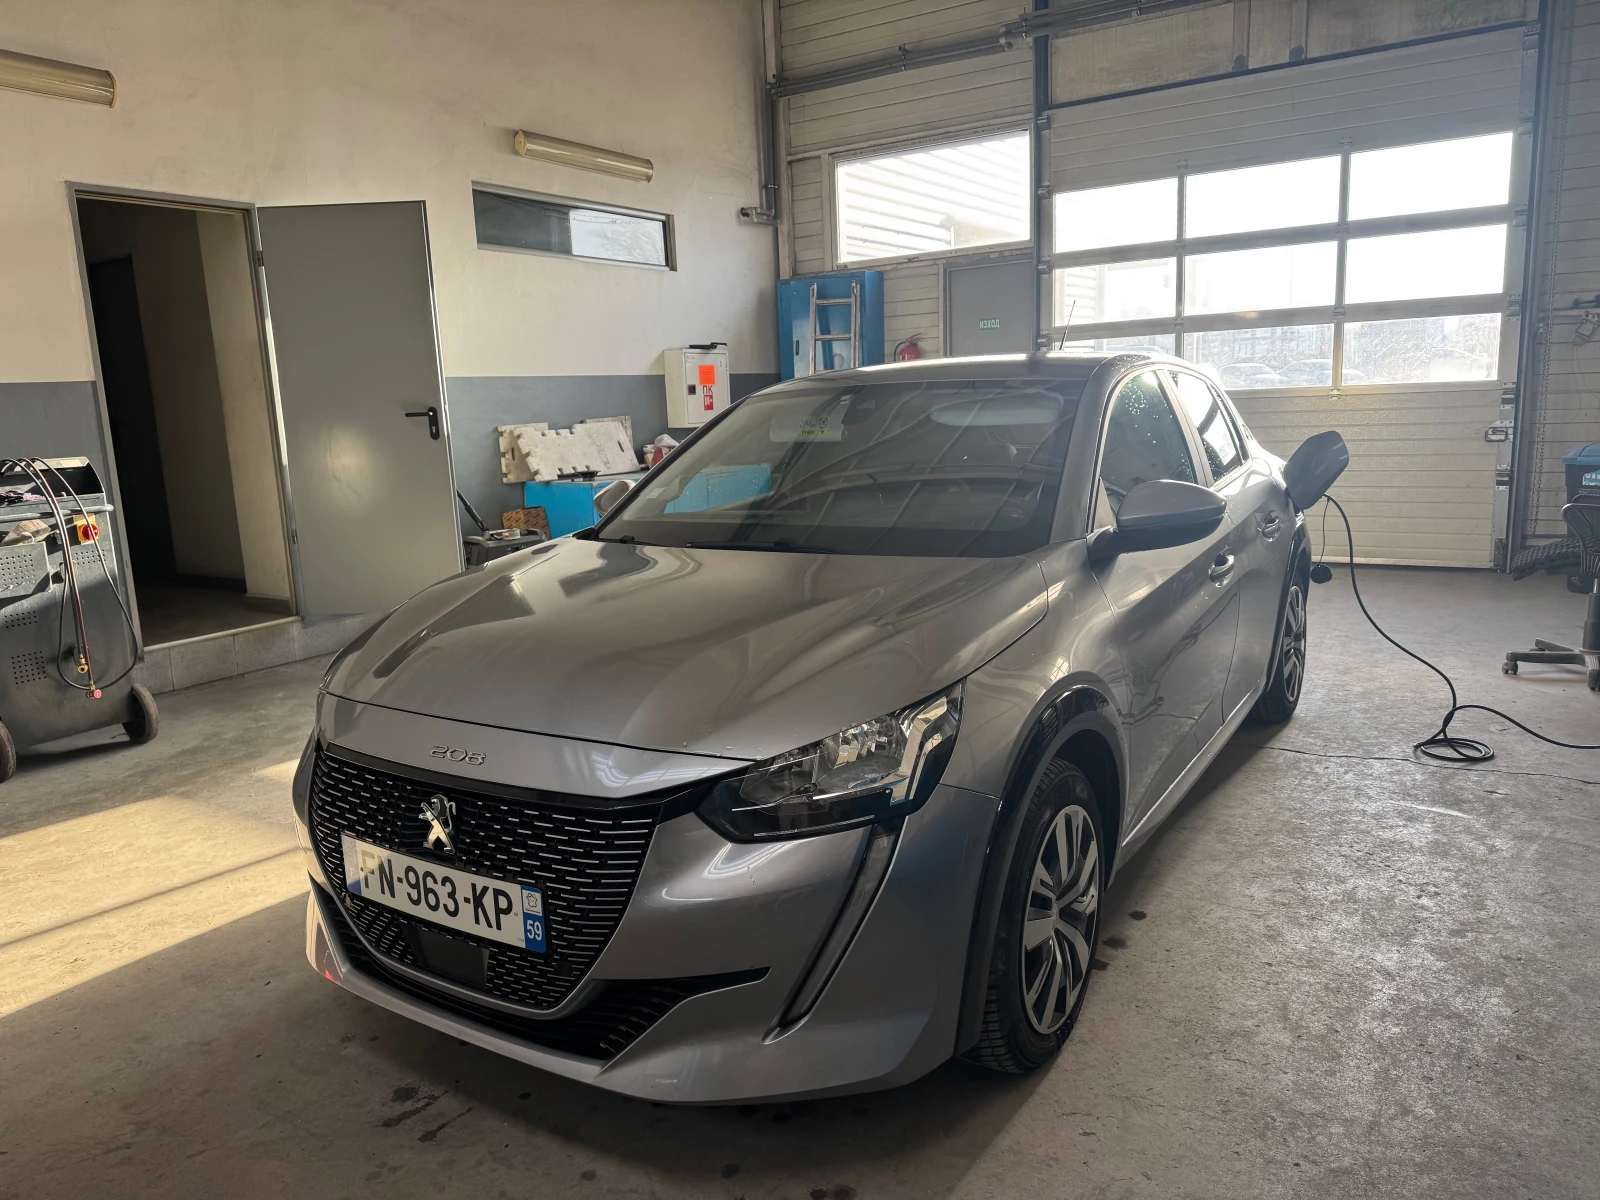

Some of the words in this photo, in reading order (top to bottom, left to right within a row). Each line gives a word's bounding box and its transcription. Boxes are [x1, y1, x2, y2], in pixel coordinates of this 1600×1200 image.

[979, 318, 1000, 330] ИЗХОД
[702, 385, 713, 395] ПК
[429, 744, 487, 766] 208
[361, 849, 513, 931] FN-963-KP
[526, 919, 543, 941] 59
